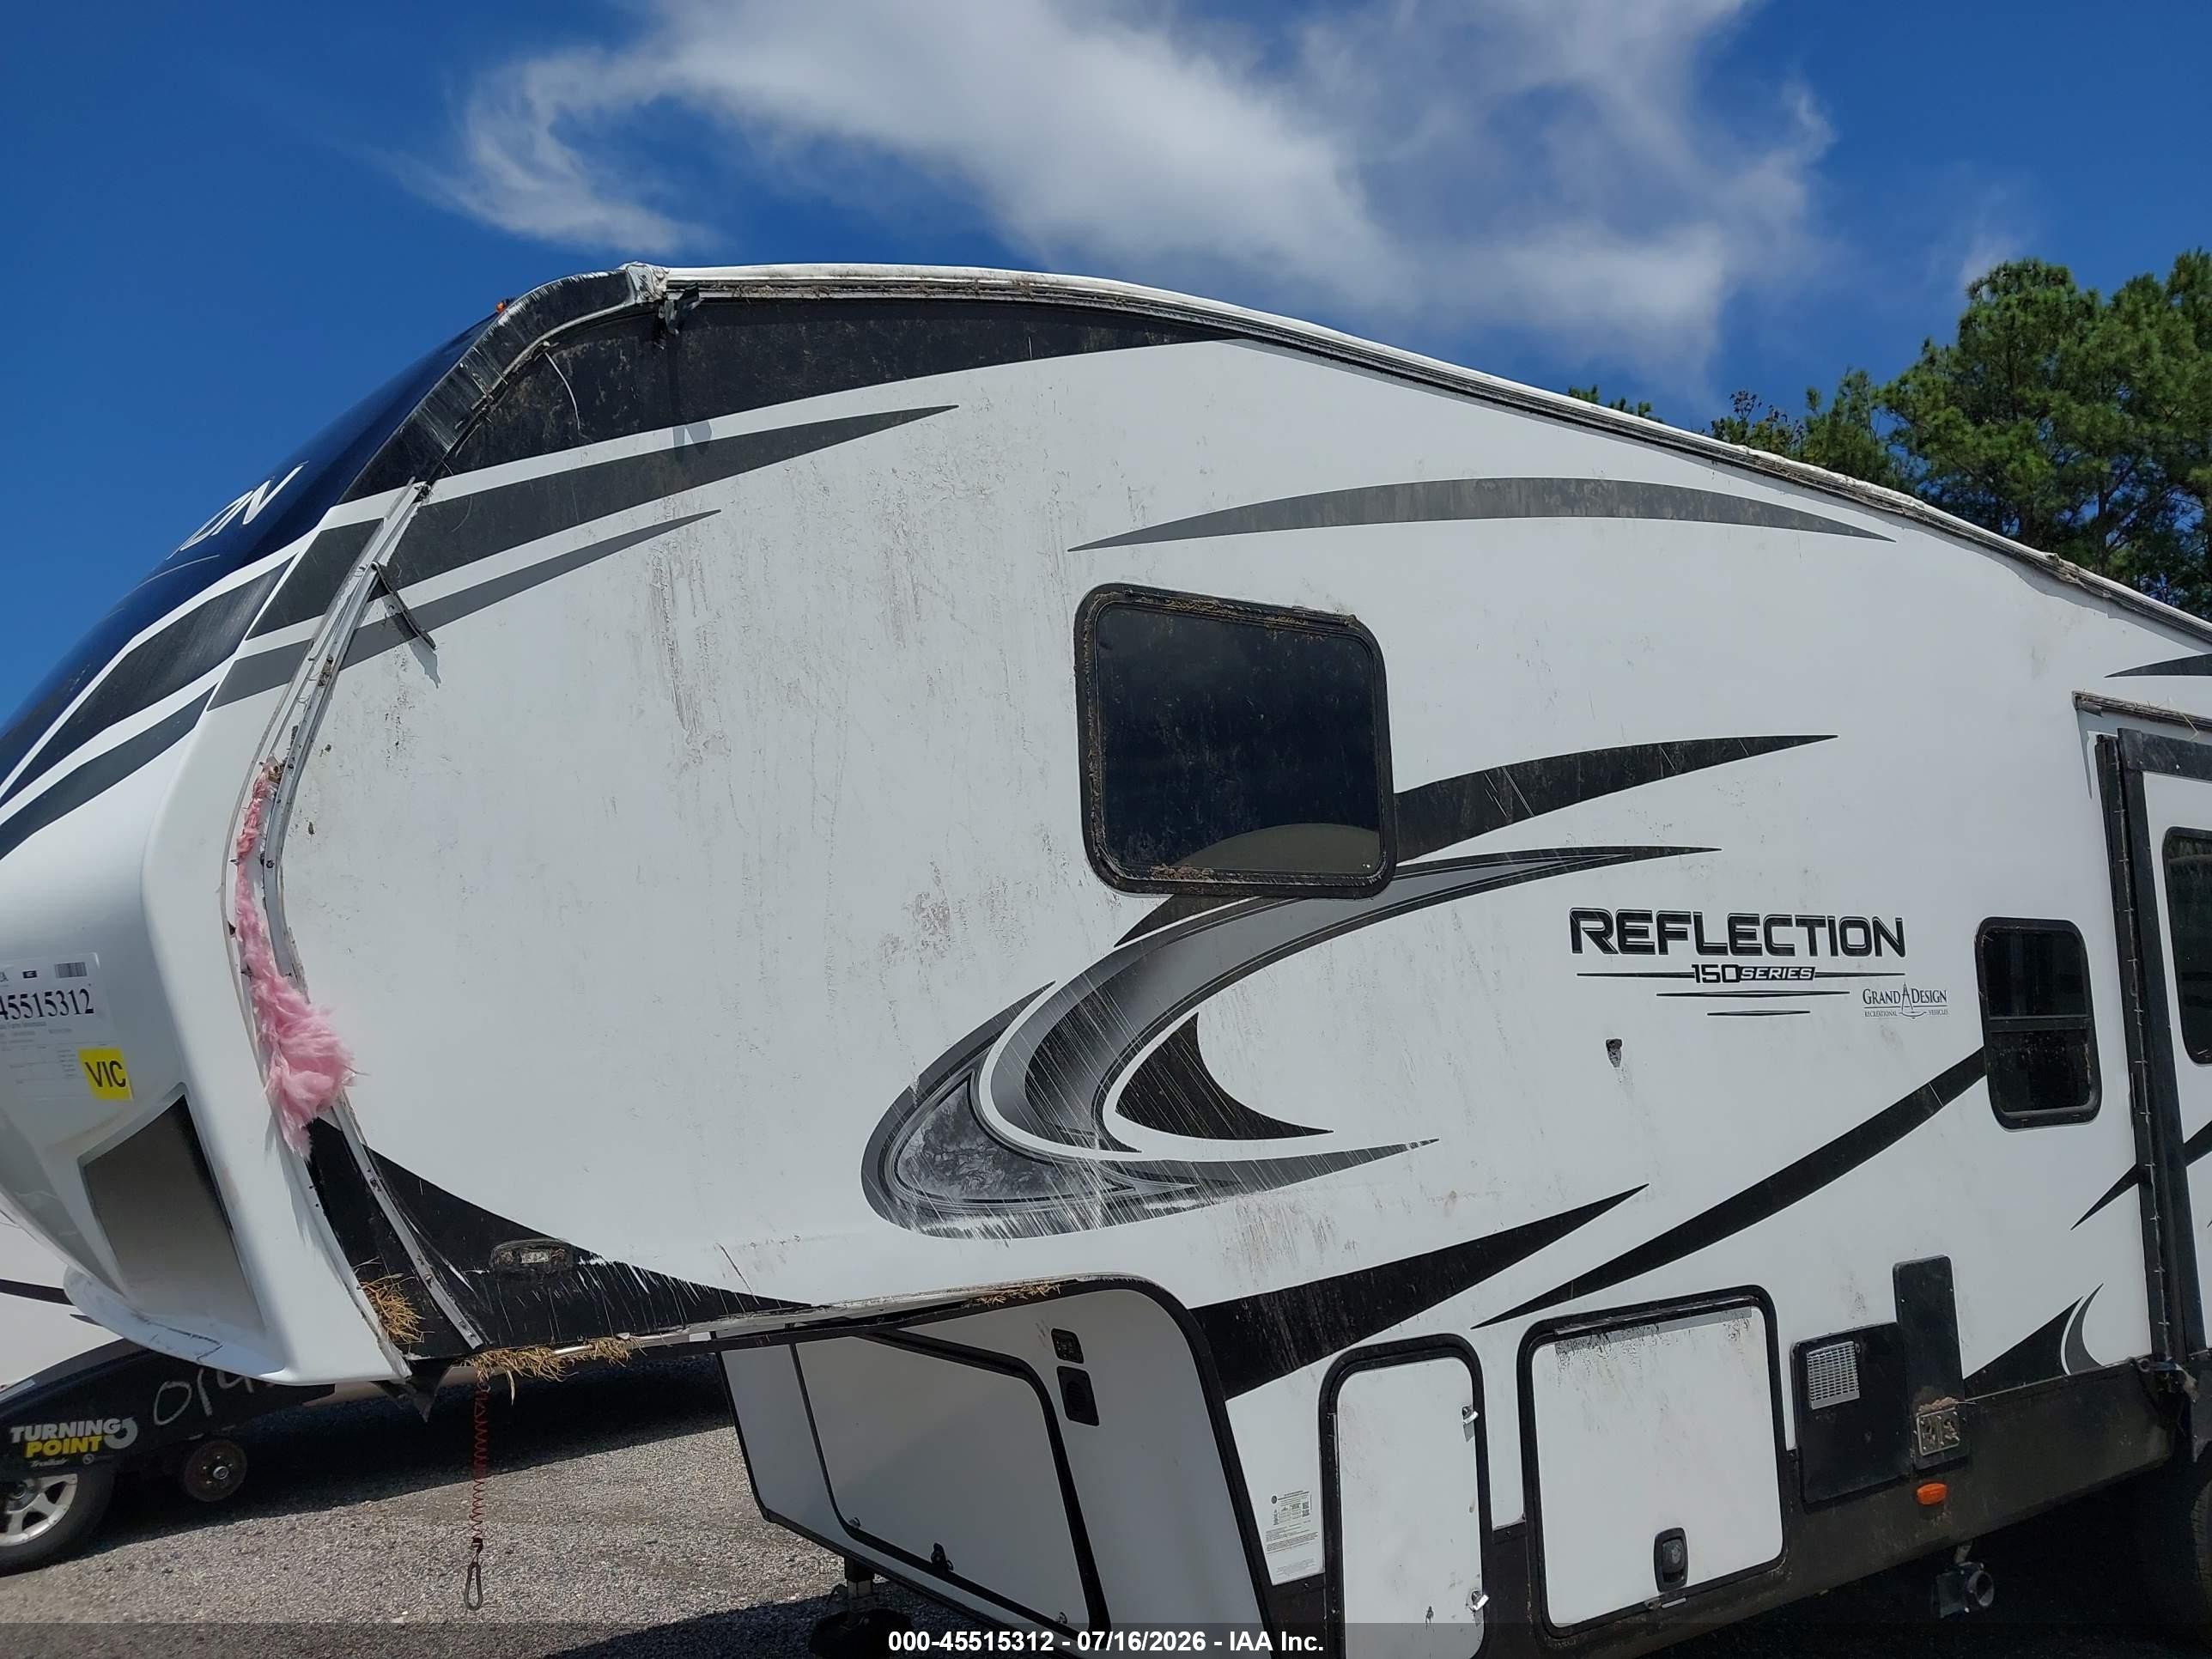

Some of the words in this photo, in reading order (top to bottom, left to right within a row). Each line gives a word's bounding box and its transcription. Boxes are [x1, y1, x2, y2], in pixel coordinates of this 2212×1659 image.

[1569, 907, 1906, 958] REFLECTION
[1691, 963, 1741, 984] 150
[1740, 967, 1814, 981] SERIES
[1863, 988, 1901, 1005] GRAND
[1910, 988, 1948, 1004] DESIGN
[84, 1060, 126, 1088] VIC
[9, 1418, 121, 1443] TURNING
[24, 1435, 102, 1458] POINT
